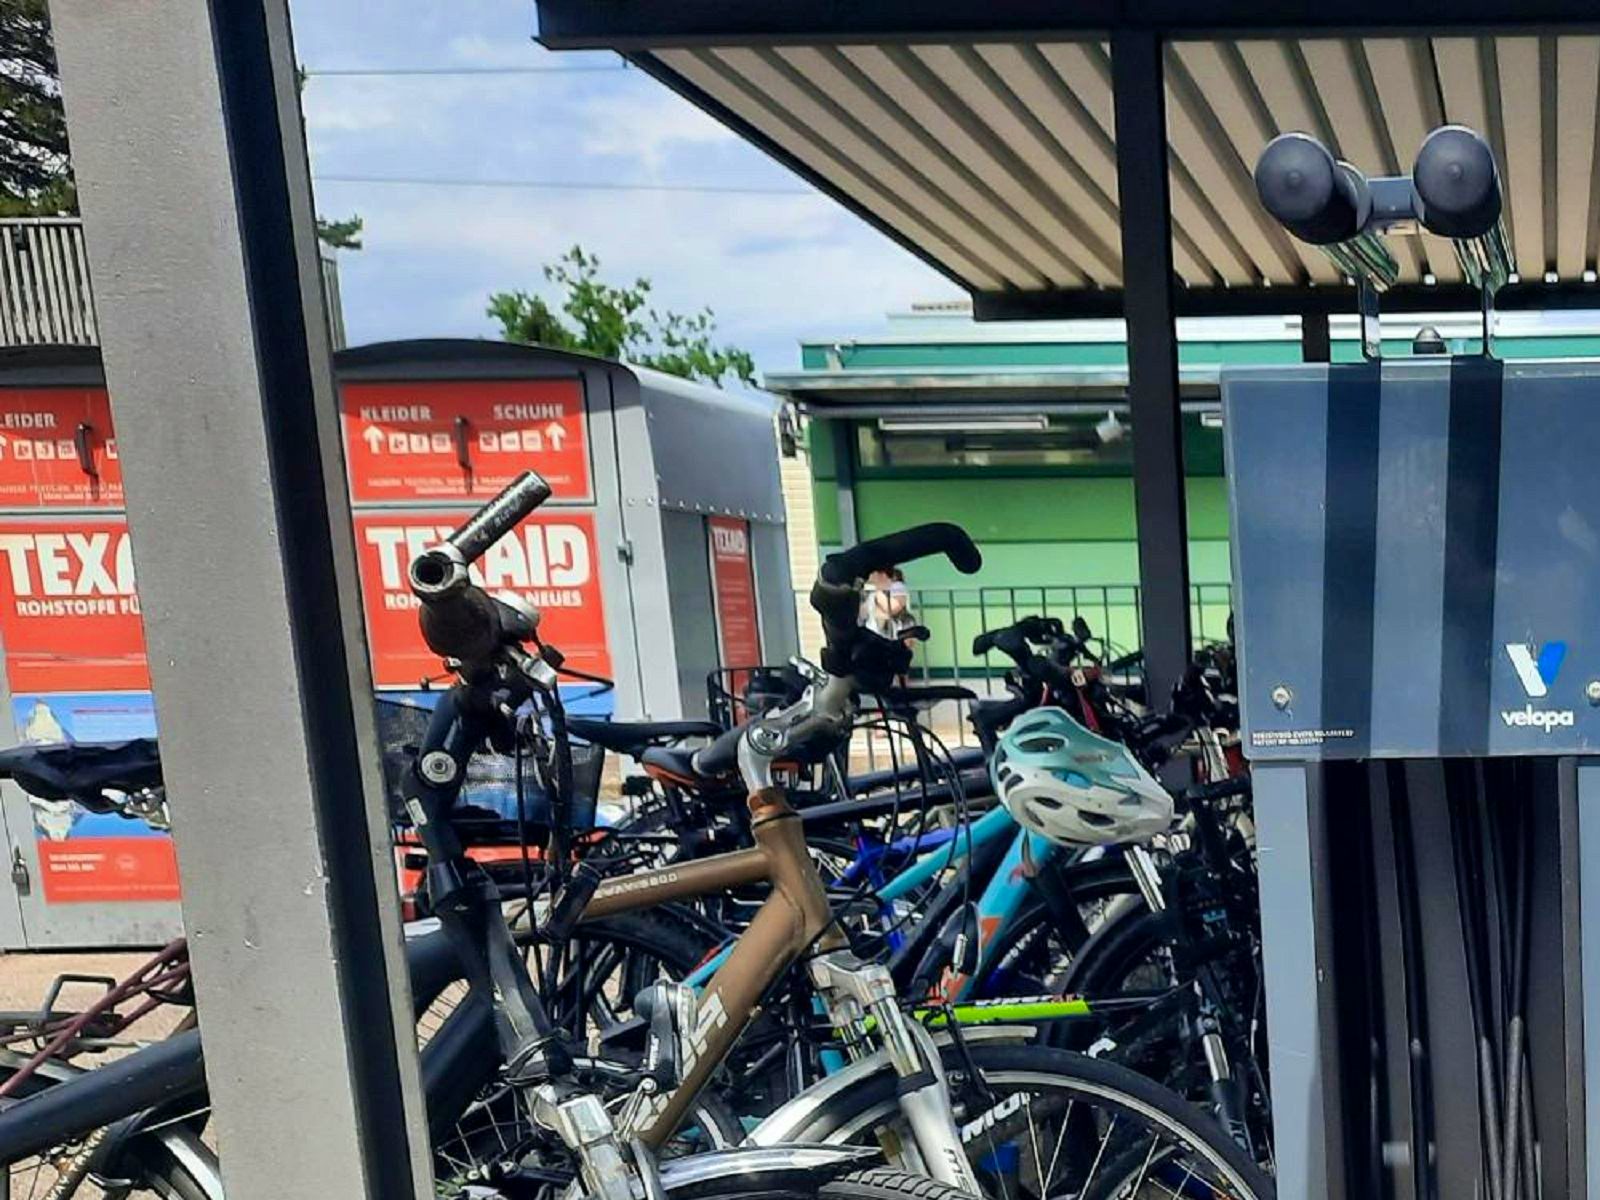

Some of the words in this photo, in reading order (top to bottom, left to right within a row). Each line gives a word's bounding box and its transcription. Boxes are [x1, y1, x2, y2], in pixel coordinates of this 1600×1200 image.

[360, 406, 432, 422] KLEIDER
[493, 404, 564, 420] SCHUHE
[0, 413, 56, 428] EIDER
[16, 600, 116, 616] ROHSTOFFE
[1500, 704, 1574, 733] velopa
